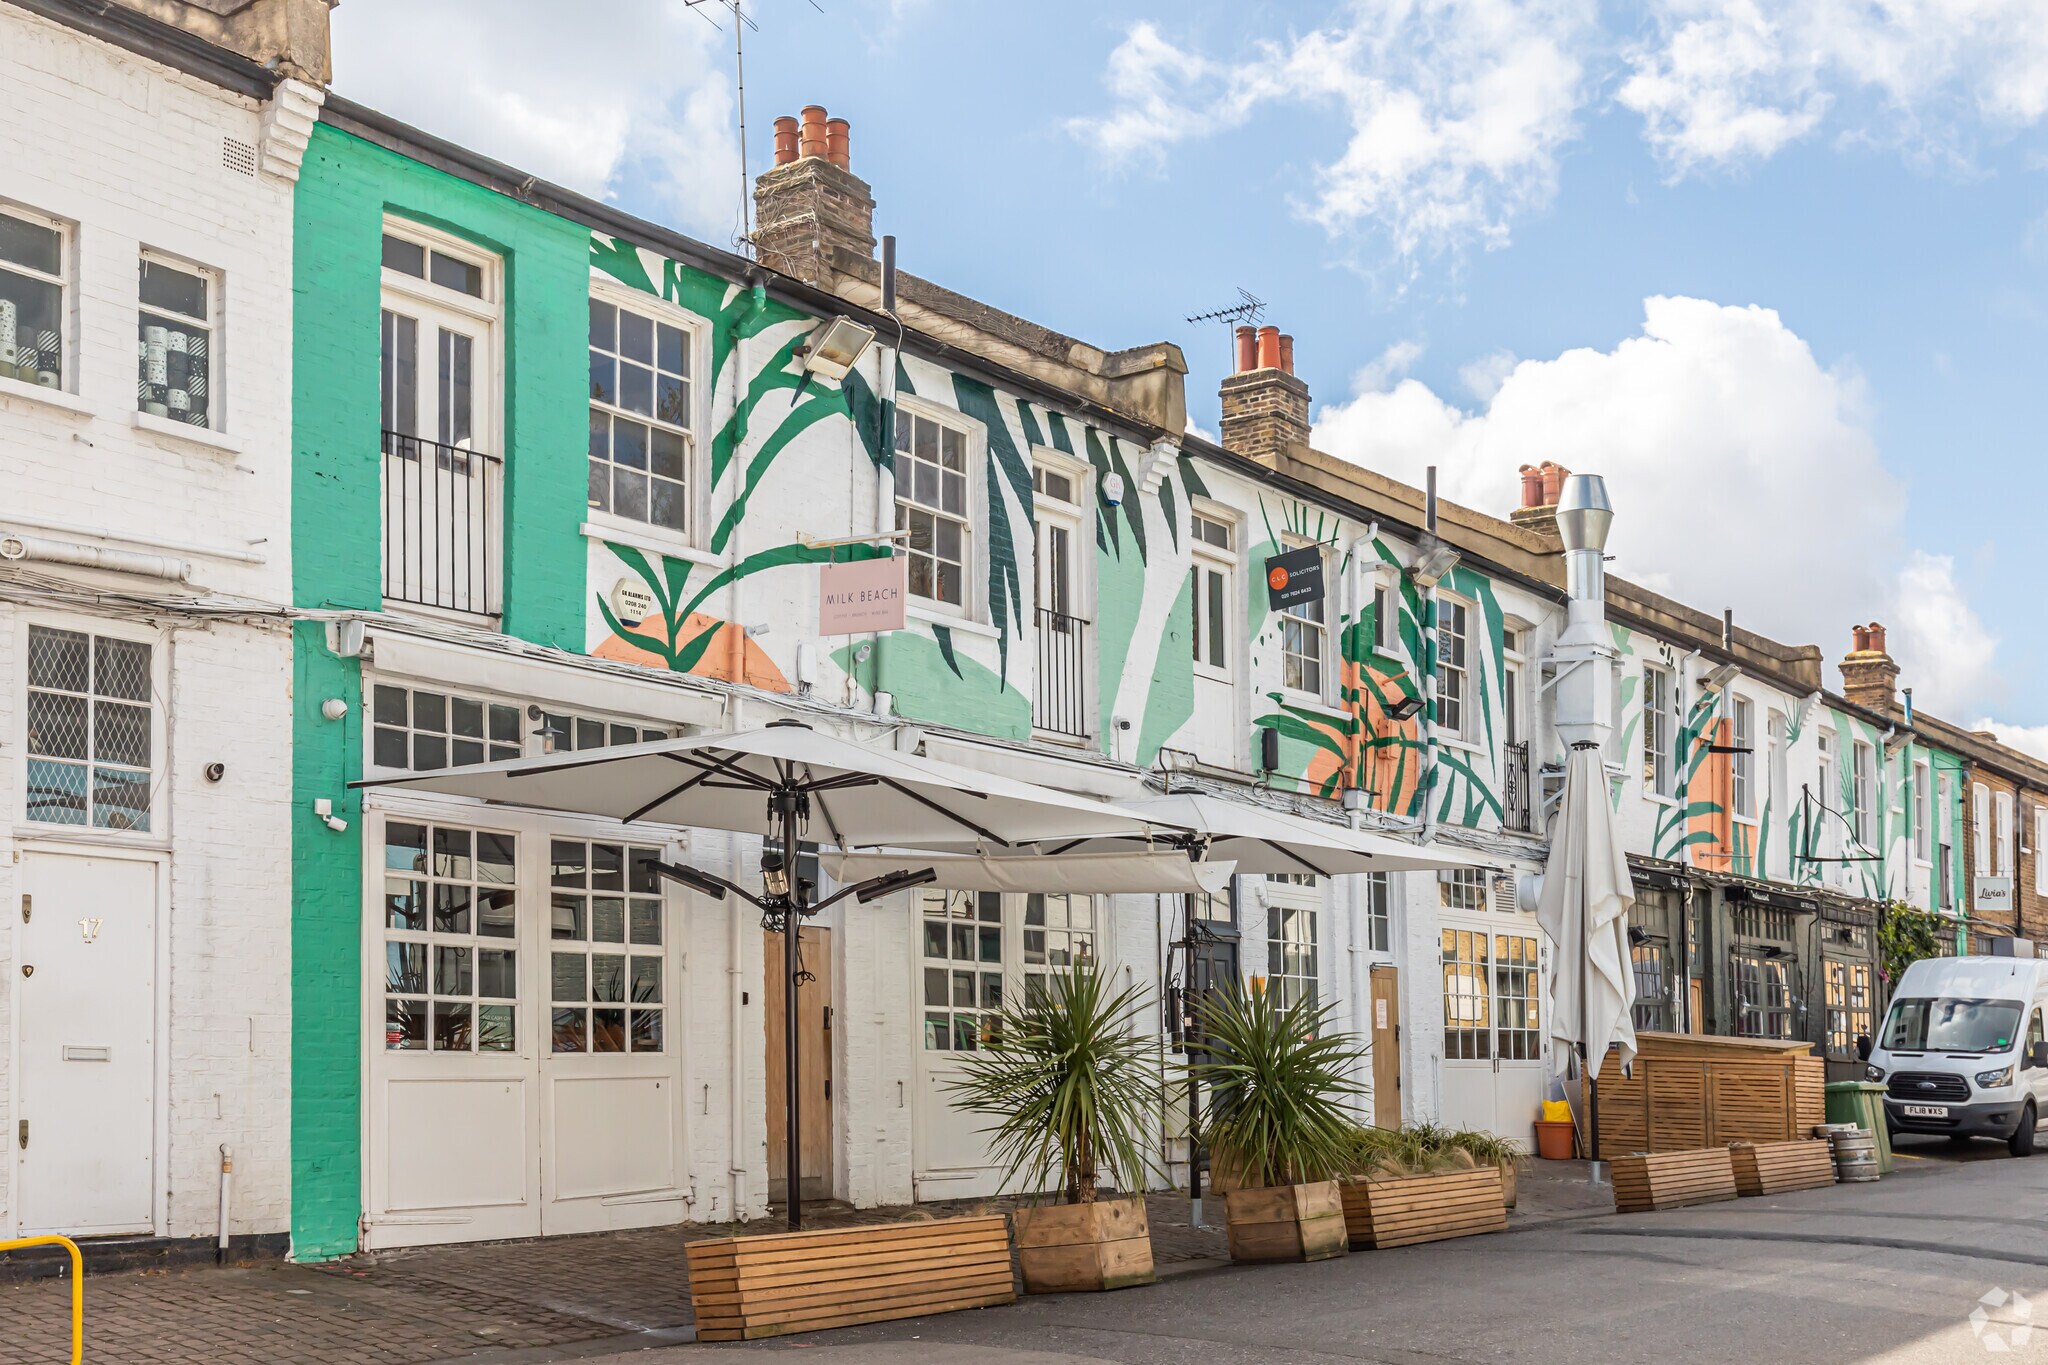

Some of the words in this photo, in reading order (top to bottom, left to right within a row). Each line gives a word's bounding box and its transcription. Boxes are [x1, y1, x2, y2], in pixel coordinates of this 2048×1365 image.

[1289, 565, 1320, 578] SOLICITORS
[628, 591, 644, 600] ALARMS
[826, 592, 854, 605] MILK
[860, 588, 898, 603] BEACH
[624, 600, 637, 608] 0208
[1979, 887, 2006, 900] Livia's
[78, 917, 104, 939] 17
[1909, 1106, 1926, 1114] FL18
[1928, 1107, 1943, 1115] WXS
